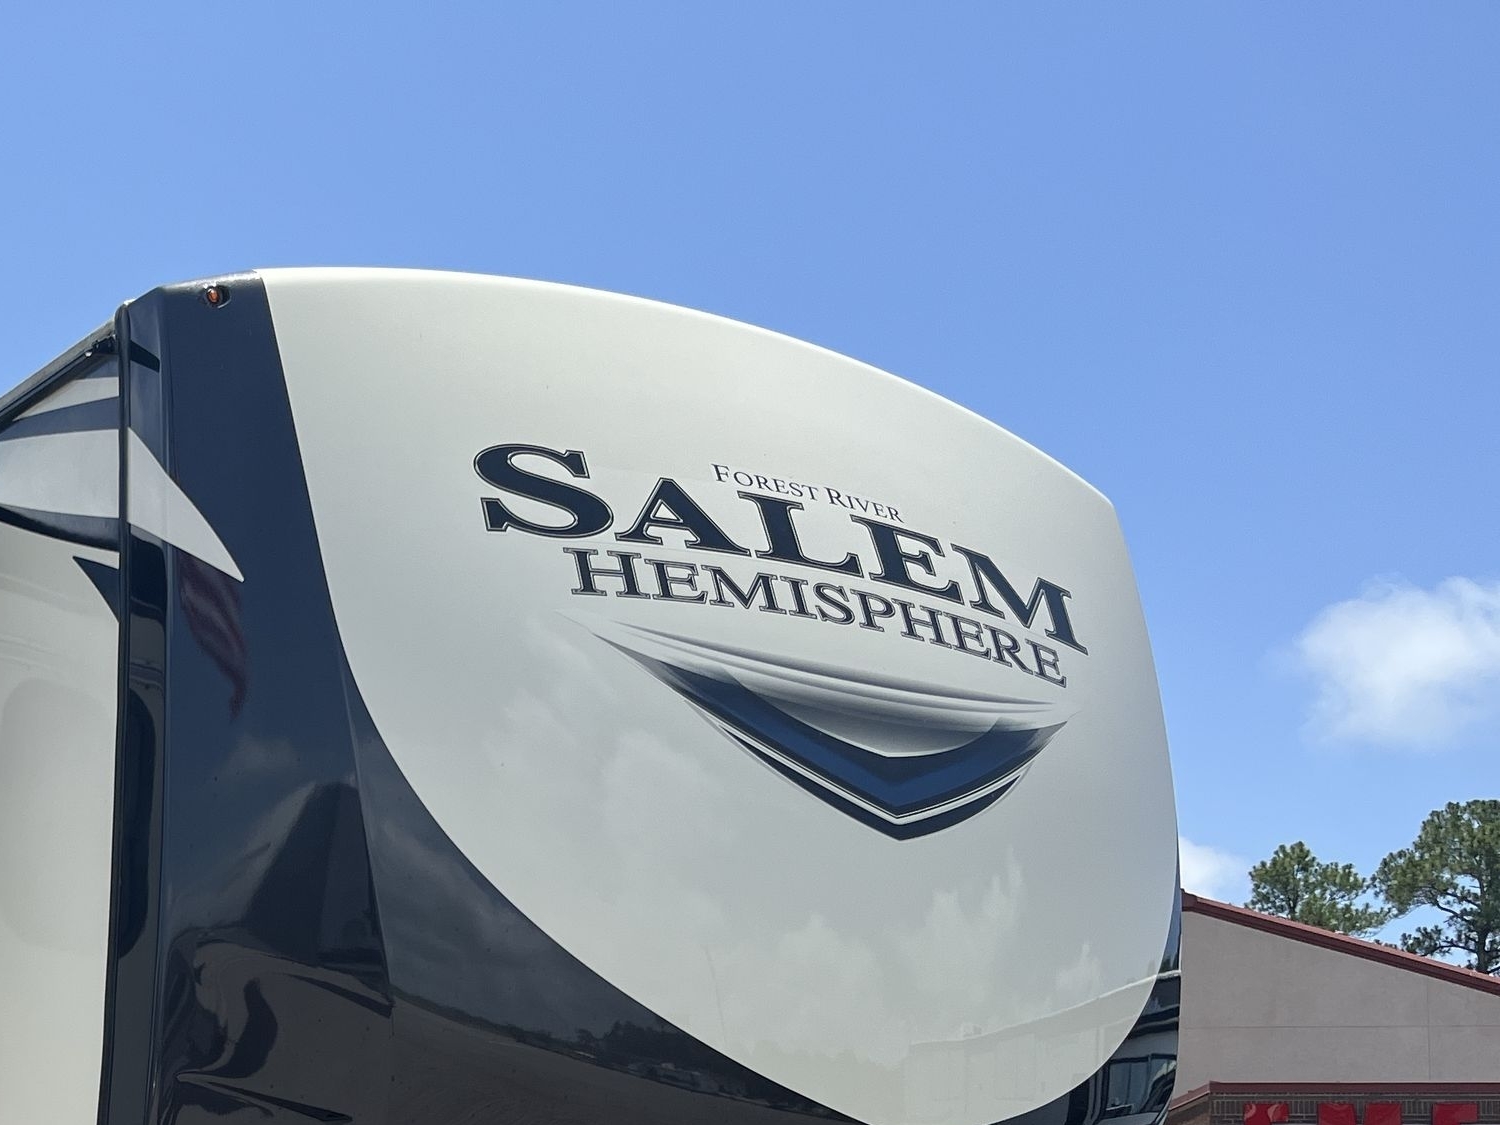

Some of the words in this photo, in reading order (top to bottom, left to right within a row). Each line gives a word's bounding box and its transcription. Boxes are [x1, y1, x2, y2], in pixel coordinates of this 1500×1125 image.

[473, 443, 1088, 656] SALEM
[710, 463, 819, 501] FOREST
[823, 486, 905, 524] RIVER
[563, 546, 1067, 689] HEMISPHERE
